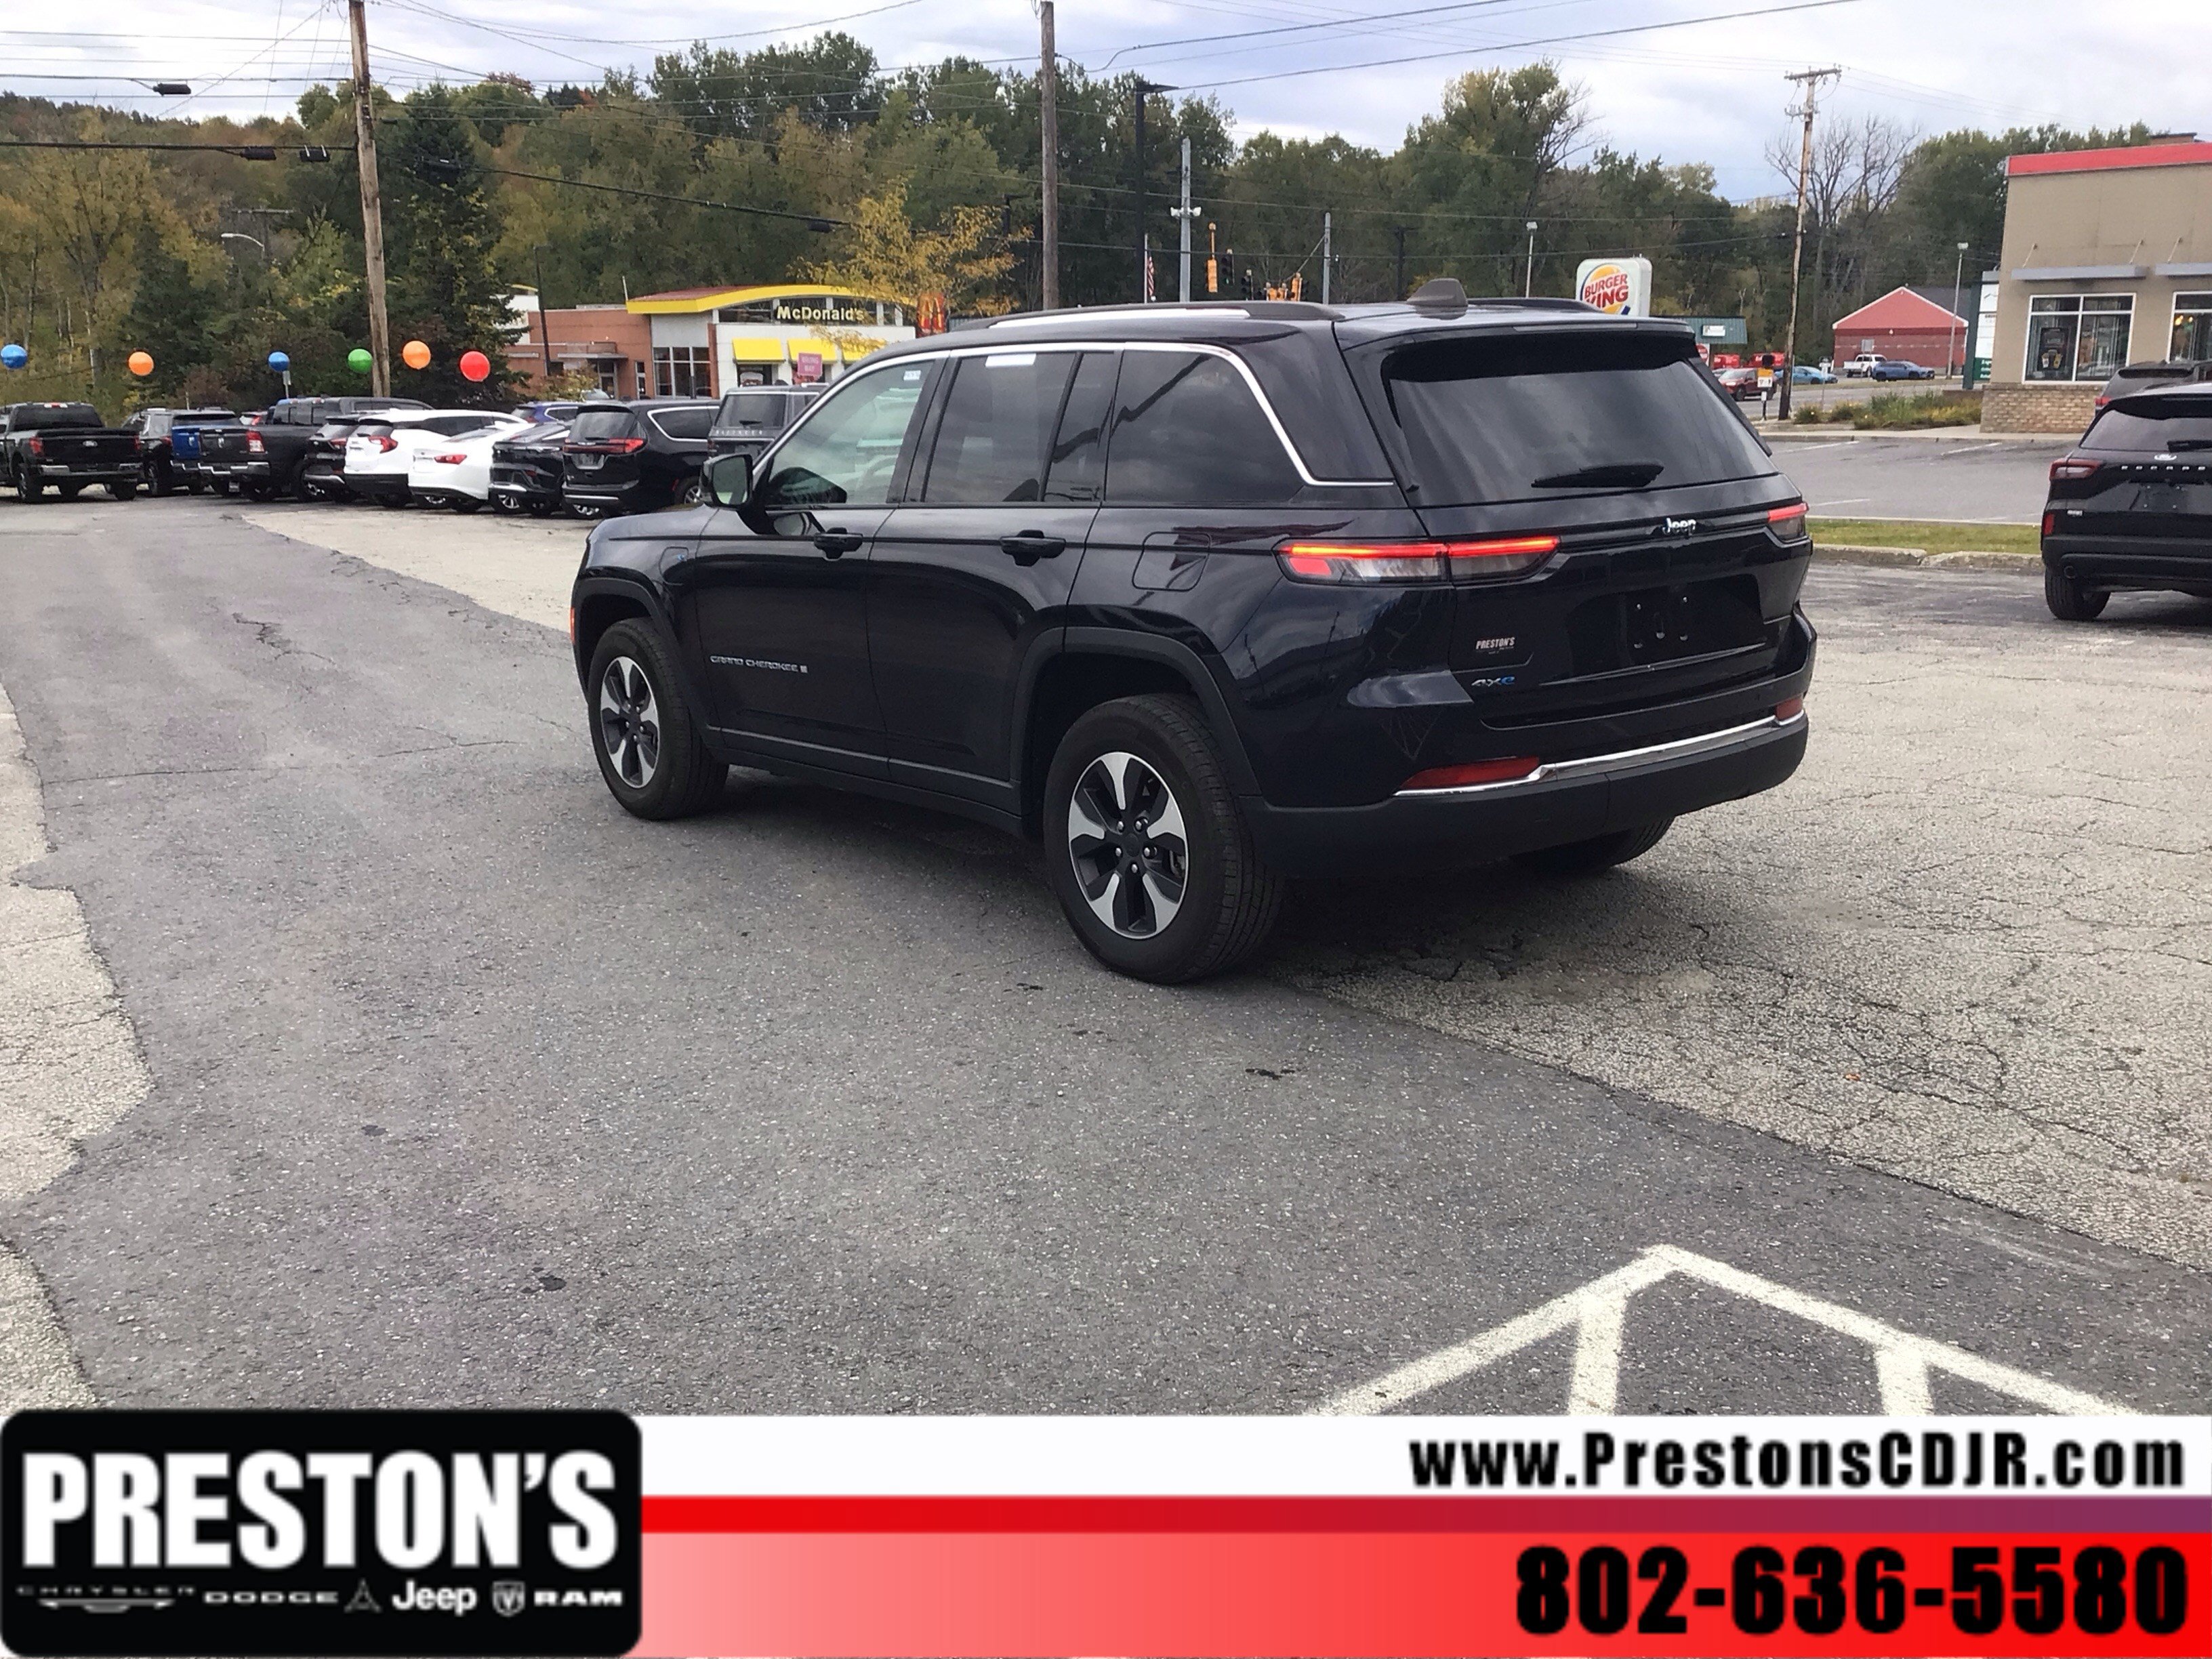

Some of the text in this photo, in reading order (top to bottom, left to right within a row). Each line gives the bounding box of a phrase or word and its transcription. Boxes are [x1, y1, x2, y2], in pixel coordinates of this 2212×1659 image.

[1584, 274, 1628, 298] BURGER
[777, 306, 865, 321] McDonald's
[1662, 517, 1696, 536] Jeep
[1475, 637, 1515, 649] PRESTON'S
[710, 655, 798, 672] GRAND CHEROKEE
